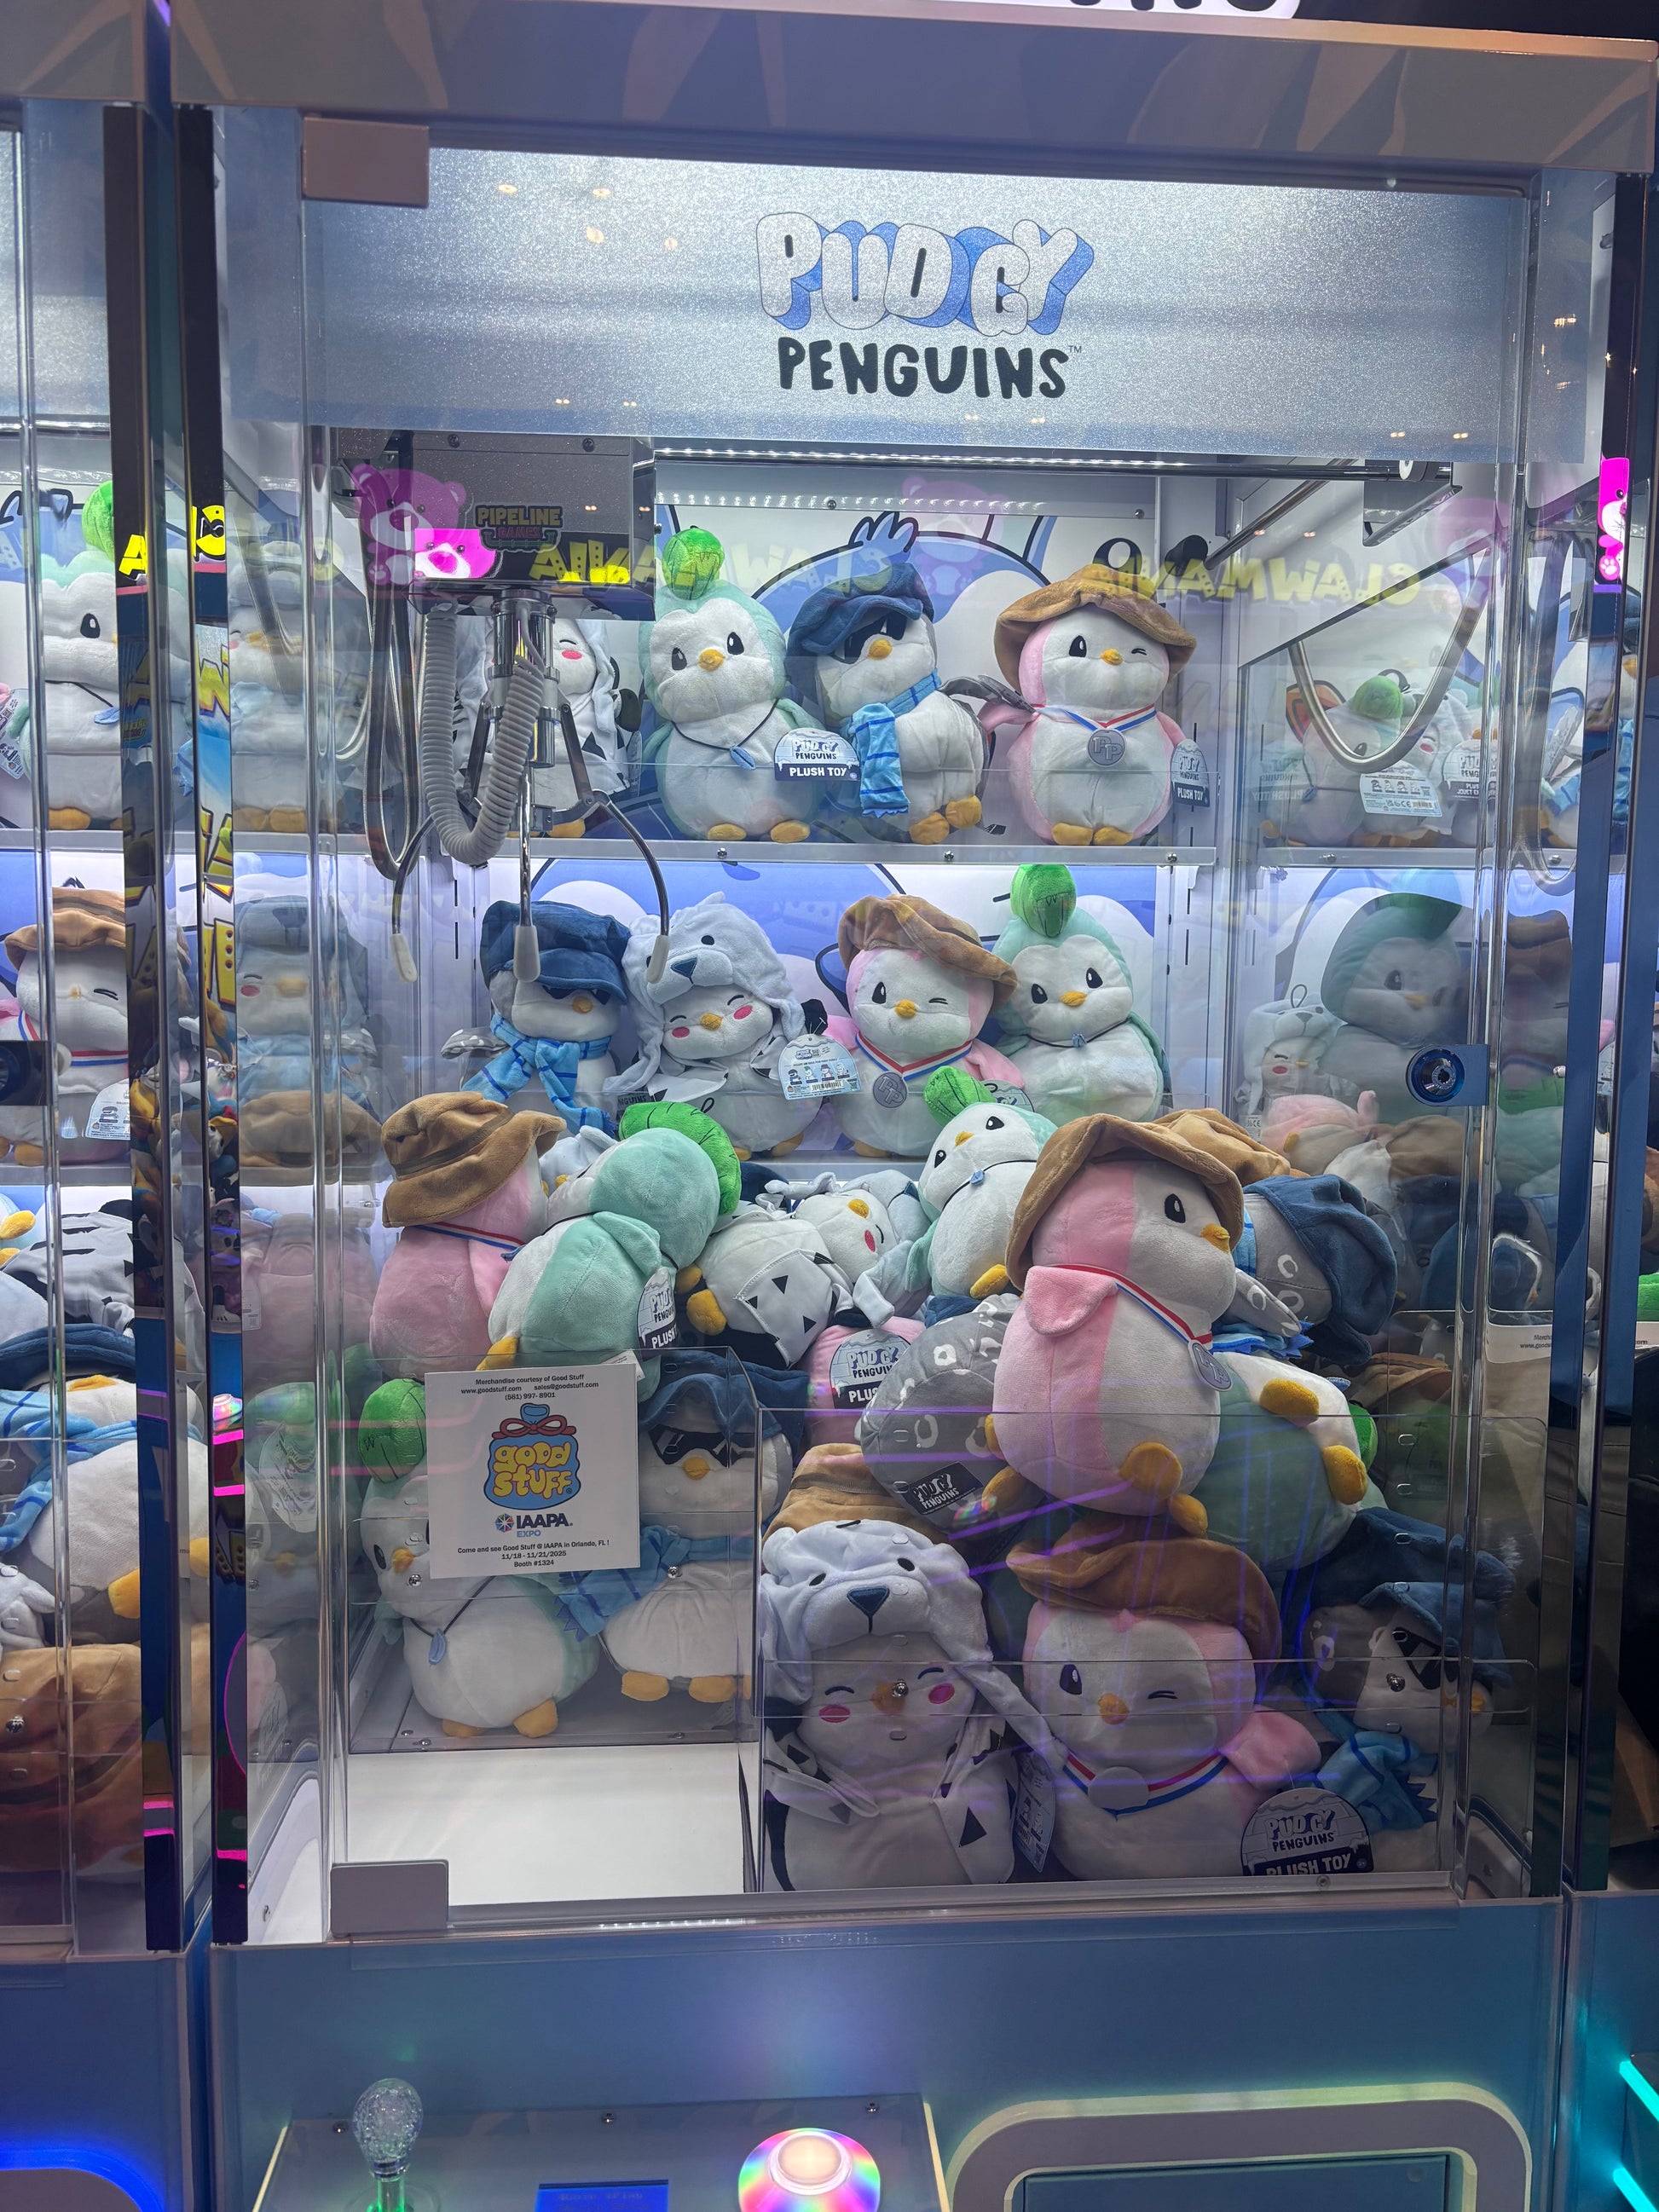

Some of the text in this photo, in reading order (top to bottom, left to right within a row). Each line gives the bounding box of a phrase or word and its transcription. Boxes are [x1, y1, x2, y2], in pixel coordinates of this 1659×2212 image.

[756, 211, 1095, 338] PUDGY
[777, 336, 1069, 400] PENGUINS
[476, 505, 562, 527] PIPELINE
[497, 527, 540, 539] GAMES
[792, 739, 839, 753] PUDGY
[789, 767, 825, 777] PLUSH
[827, 767, 847, 777] TOY
[1177, 787, 1194, 800] PLUSH
[1194, 789, 1205, 801] TOY
[847, 1347, 899, 1369] PUDGY
[461, 1382, 599, 1395] www.goodstuff.com sales@goodstuff.com
[493, 1441, 571, 1473] good
[922, 1487, 959, 1510] PENGUINS
[1265, 1808, 1336, 1840] PUDGY
[1273, 1832, 1335, 1851] PENGUINS
[1322, 1853, 1350, 1872] TOY
